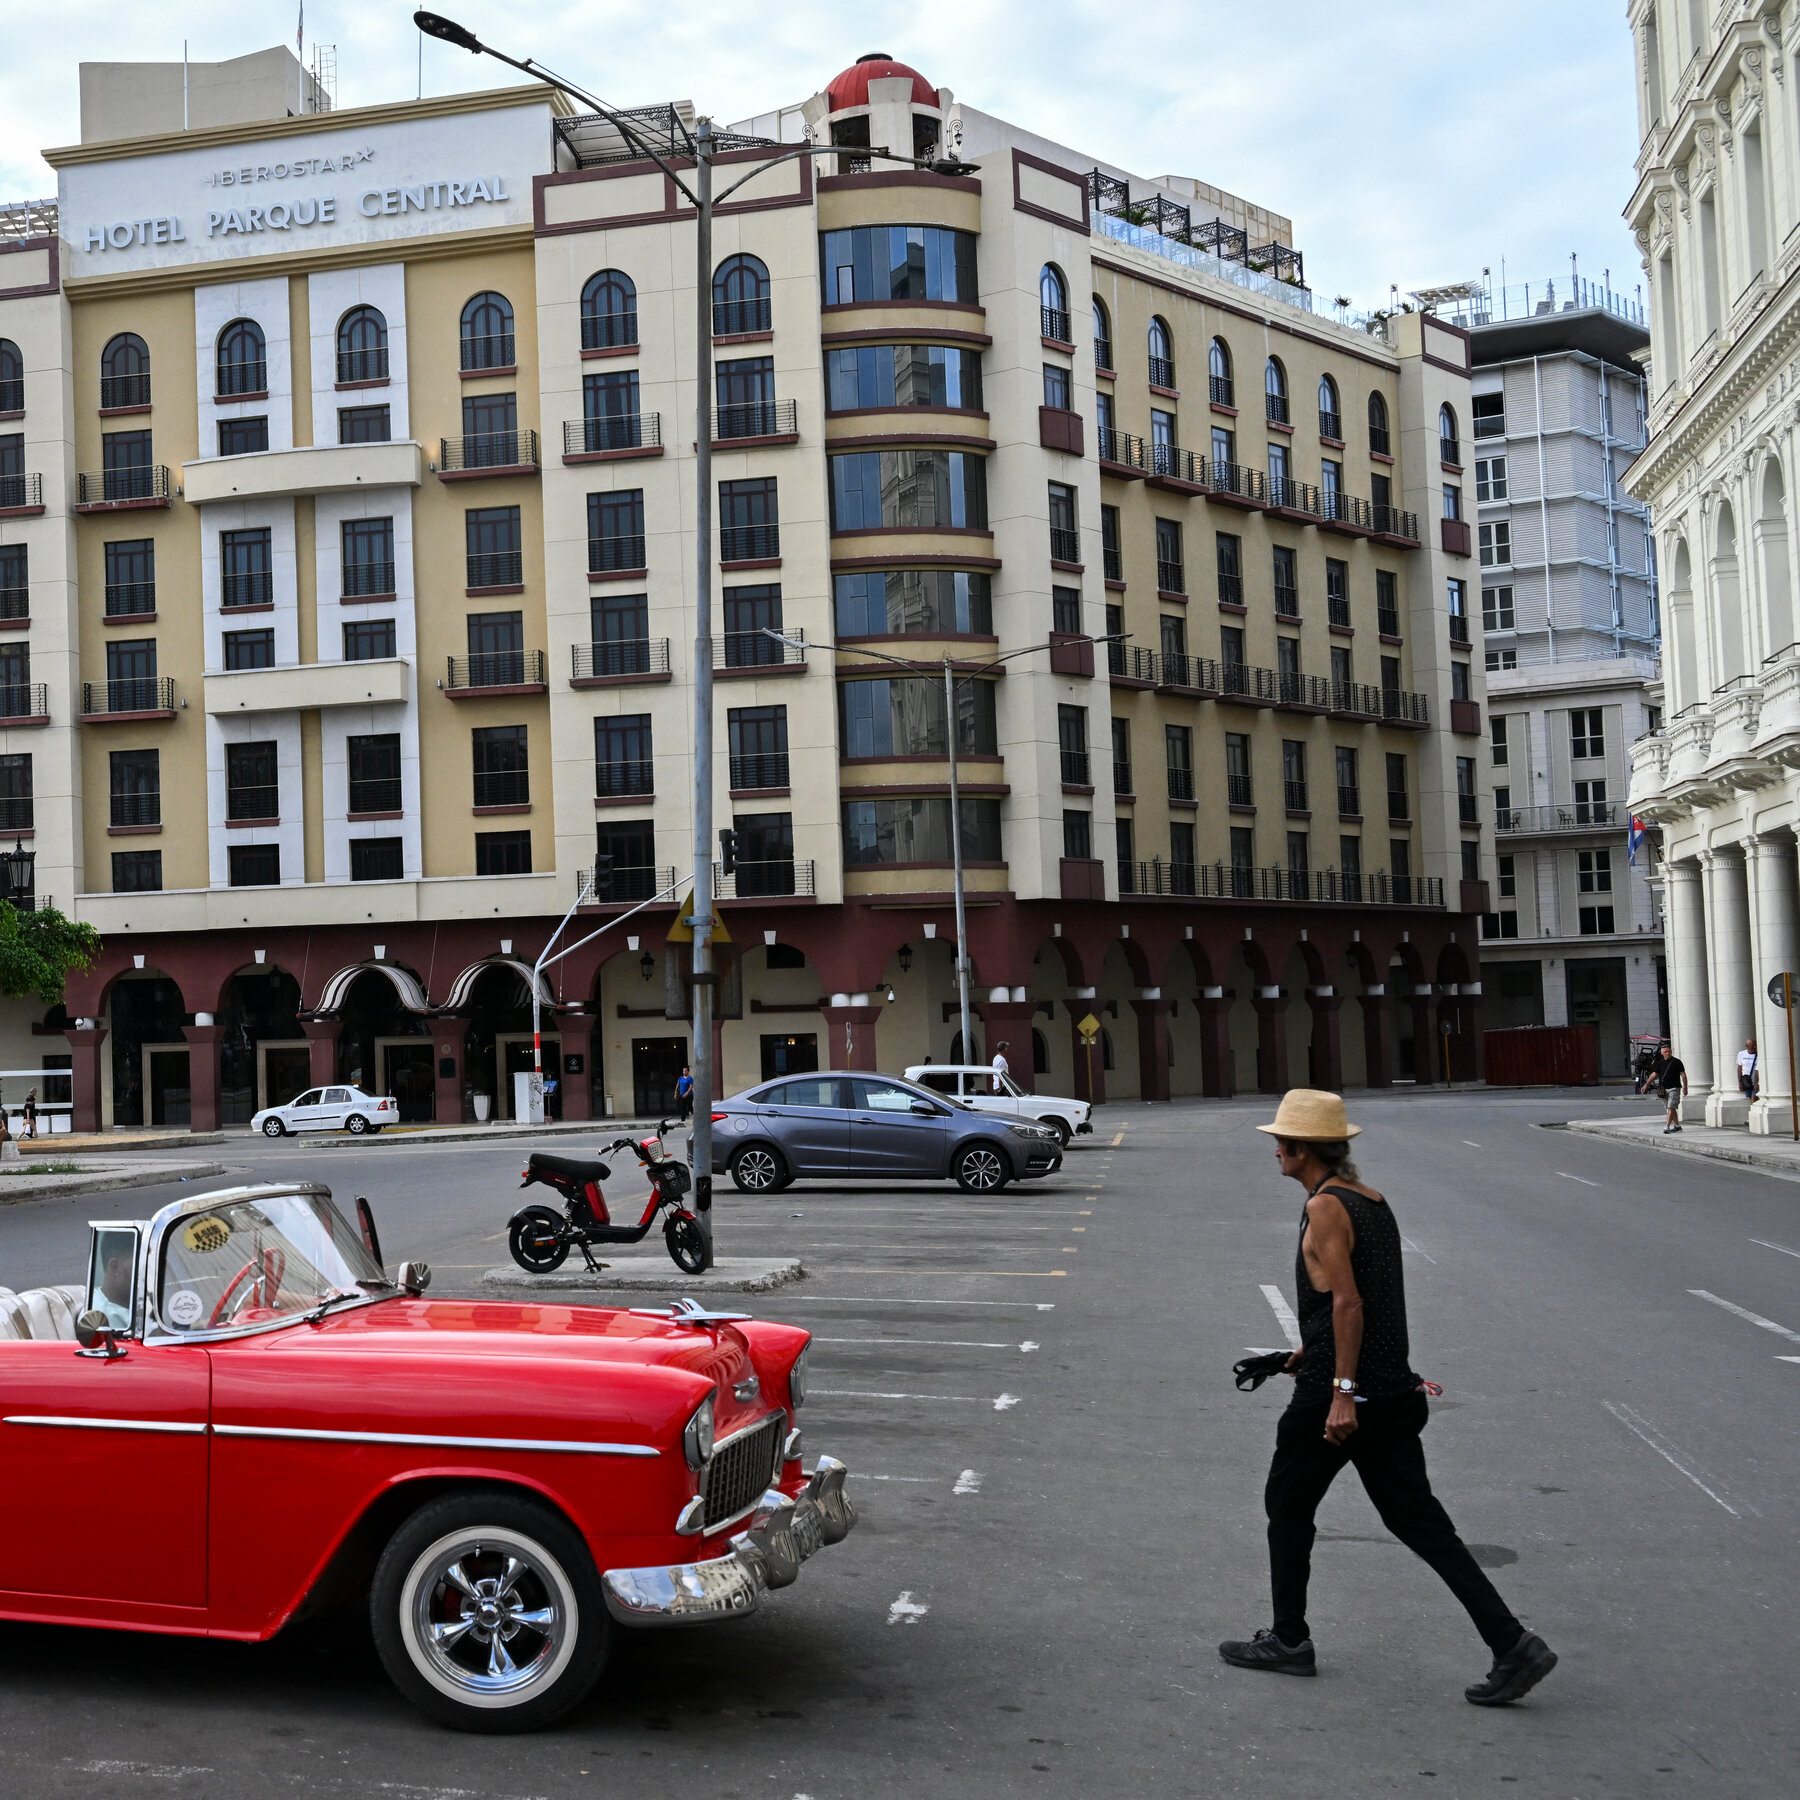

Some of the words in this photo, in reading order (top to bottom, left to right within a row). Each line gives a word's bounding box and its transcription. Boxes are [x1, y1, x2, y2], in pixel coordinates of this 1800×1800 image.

[211, 155, 354, 187] IBEROSTAR
[84, 216, 185, 252] HOTEL
[207, 196, 335, 237] PARQUE
[359, 175, 509, 217] CENTRAL
